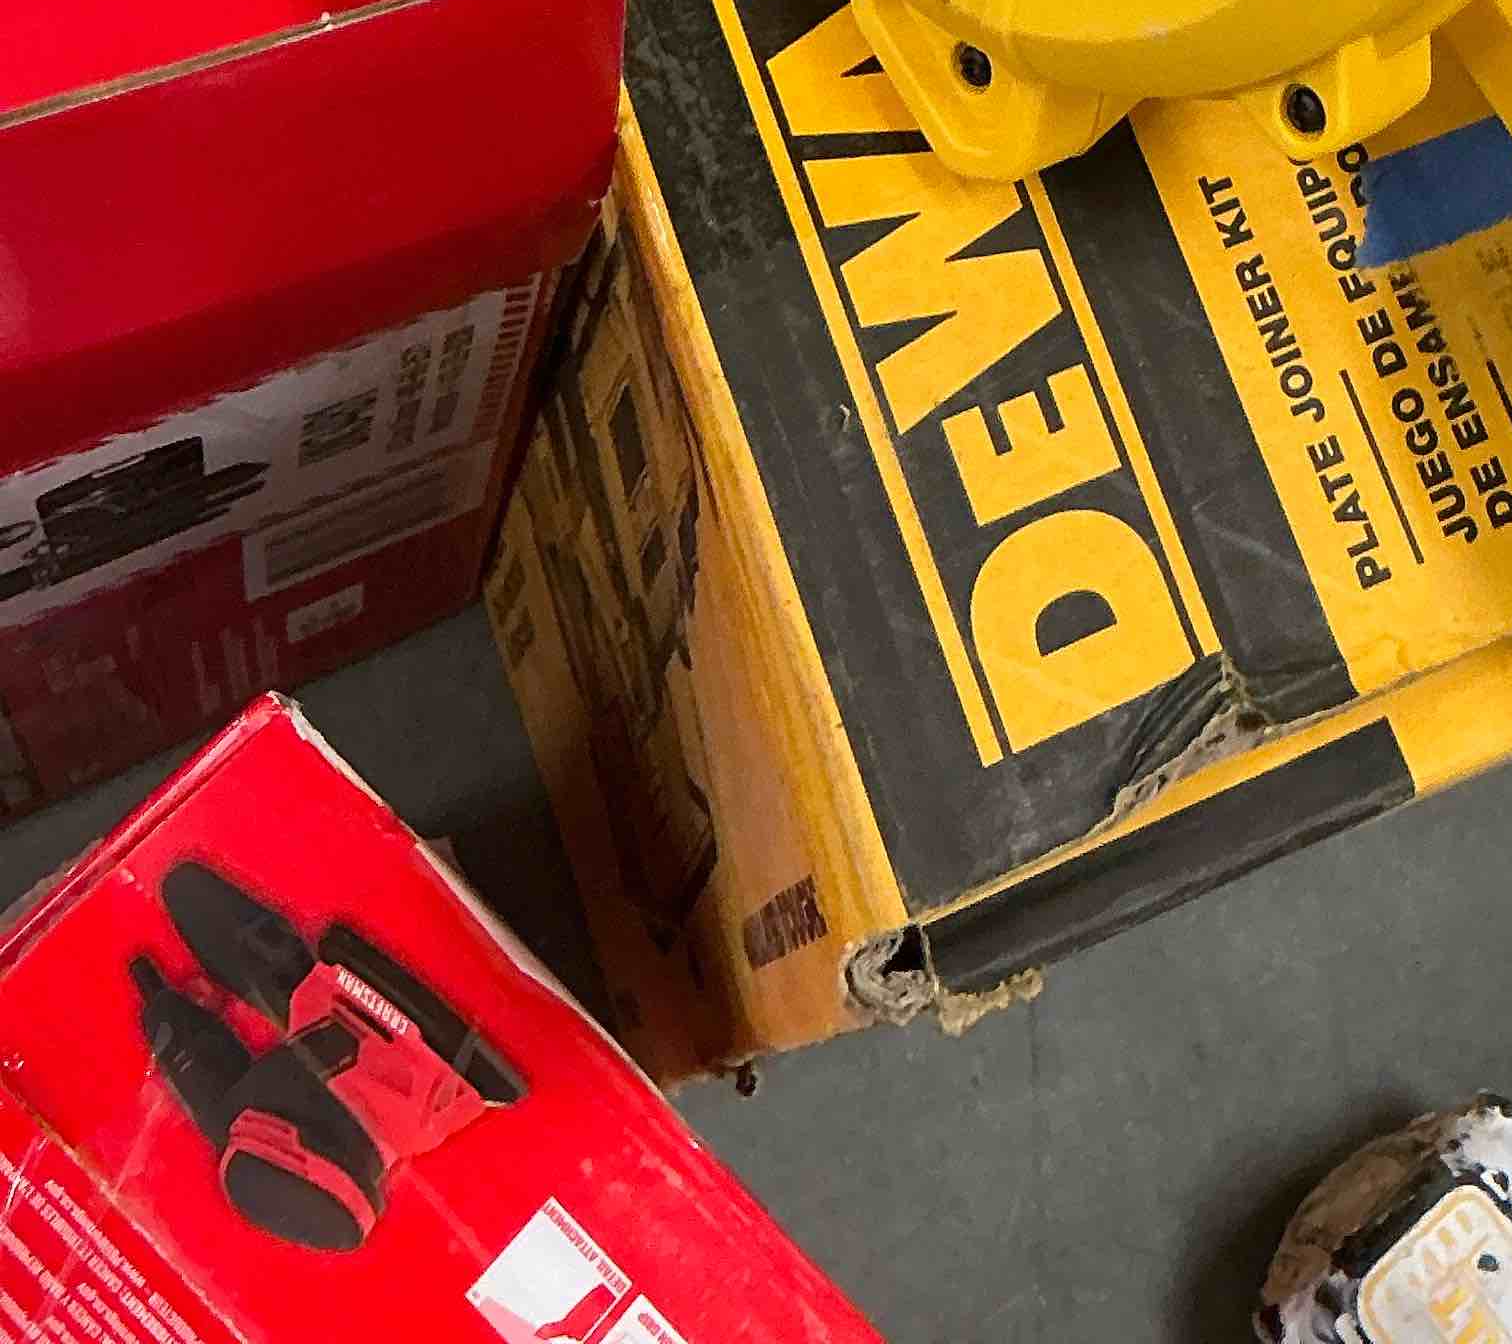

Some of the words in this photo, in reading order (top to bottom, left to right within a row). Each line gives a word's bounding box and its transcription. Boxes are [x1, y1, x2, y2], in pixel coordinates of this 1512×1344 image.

[1199, 175, 1254, 251] KIT
[1288, 155, 1377, 304] EQUIP
[1234, 252, 1326, 424] JOINER
[1356, 306, 1409, 379] DE
[1305, 434, 1393, 591] PLATE
[1391, 387, 1480, 544] JUEGO
